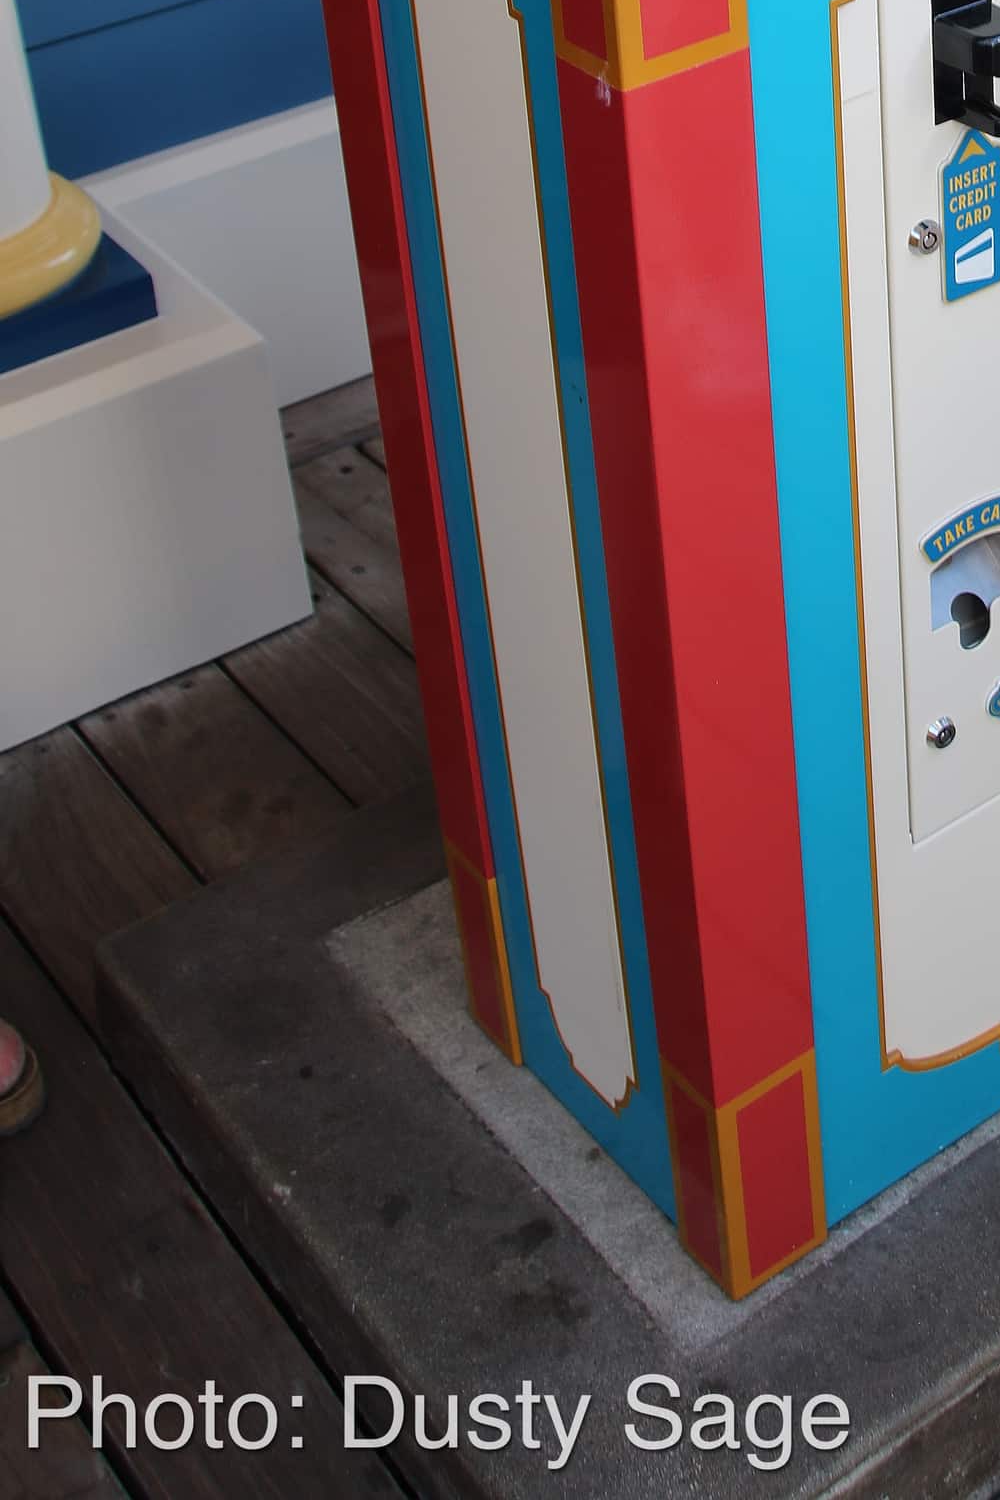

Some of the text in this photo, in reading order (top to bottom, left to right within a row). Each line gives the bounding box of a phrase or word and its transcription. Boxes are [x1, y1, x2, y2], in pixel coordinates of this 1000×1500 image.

[949, 161, 997, 193] INSERT
[949, 182, 997, 214] CREDIT
[955, 204, 992, 231] CARD
[933, 516, 975, 553] TAKE
